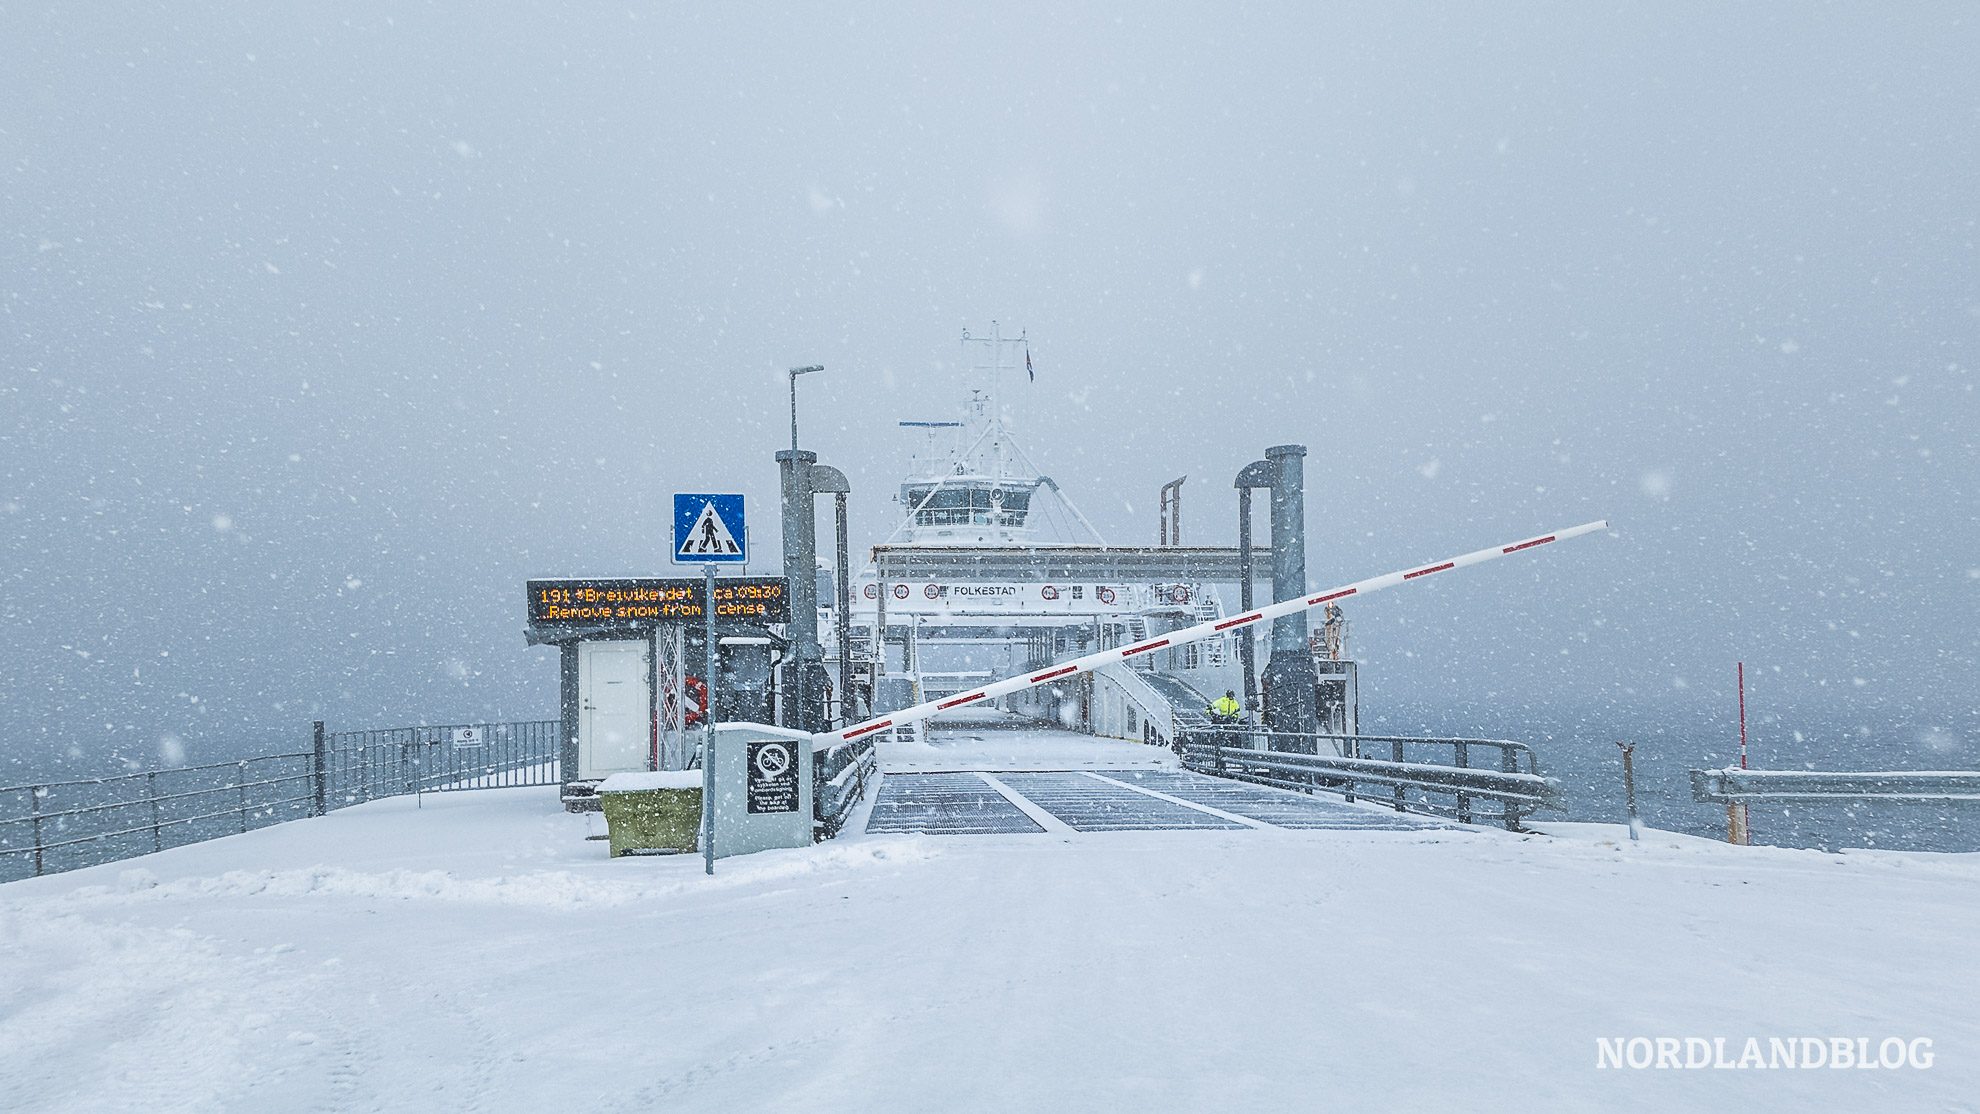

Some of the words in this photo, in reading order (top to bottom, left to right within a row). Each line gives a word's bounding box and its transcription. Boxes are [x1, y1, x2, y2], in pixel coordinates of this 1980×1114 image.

[541, 588, 570, 603] 191
[738, 585, 781, 599] 09:30
[954, 586, 1016, 596] FOLKESTAD
[617, 605, 658, 618] snow
[662, 604, 701, 616] from
[715, 602, 766, 616] cense
